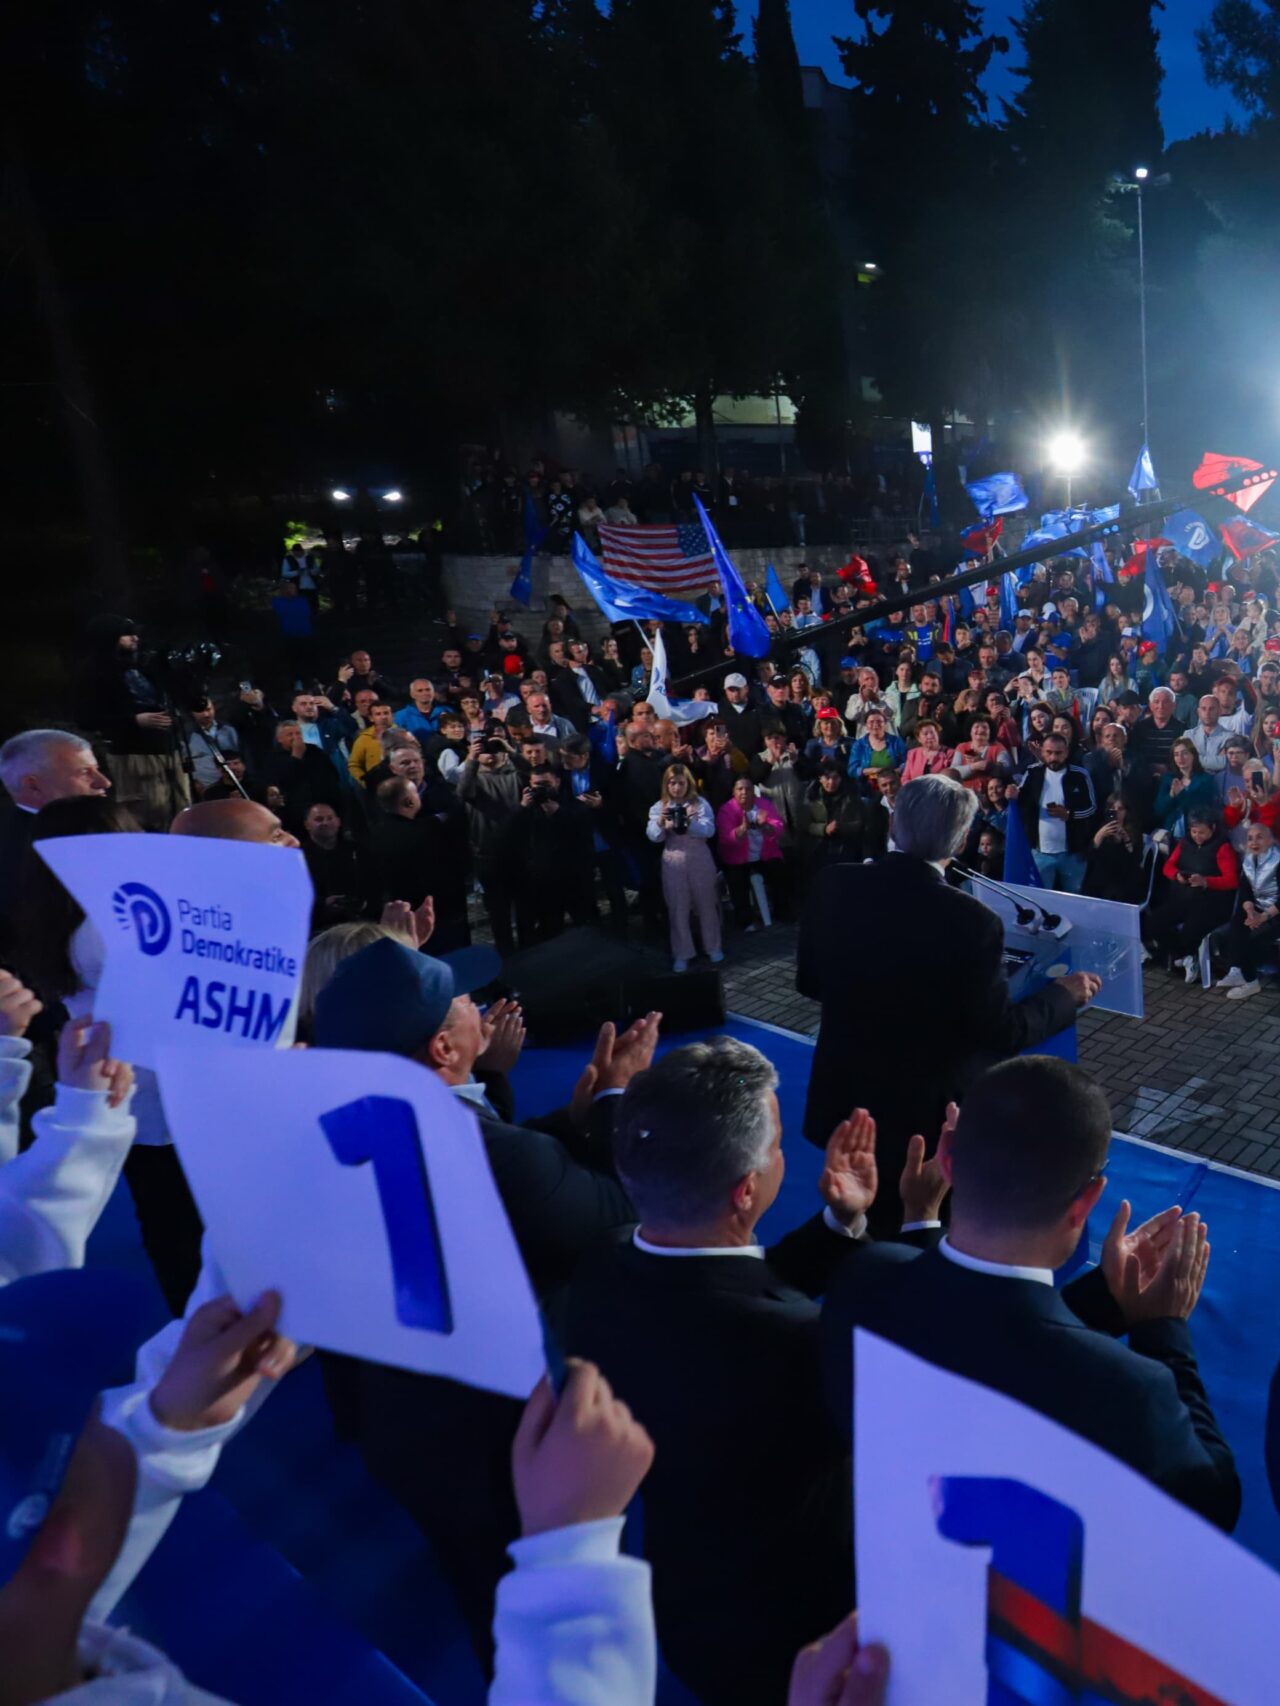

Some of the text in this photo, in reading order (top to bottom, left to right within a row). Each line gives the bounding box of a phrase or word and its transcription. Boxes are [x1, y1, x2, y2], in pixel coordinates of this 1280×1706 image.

[177, 899, 233, 931] Partia
[181, 929, 297, 977] Demokratike
[174, 975, 292, 1042] ASHM
[318, 1094, 454, 1336] 1
